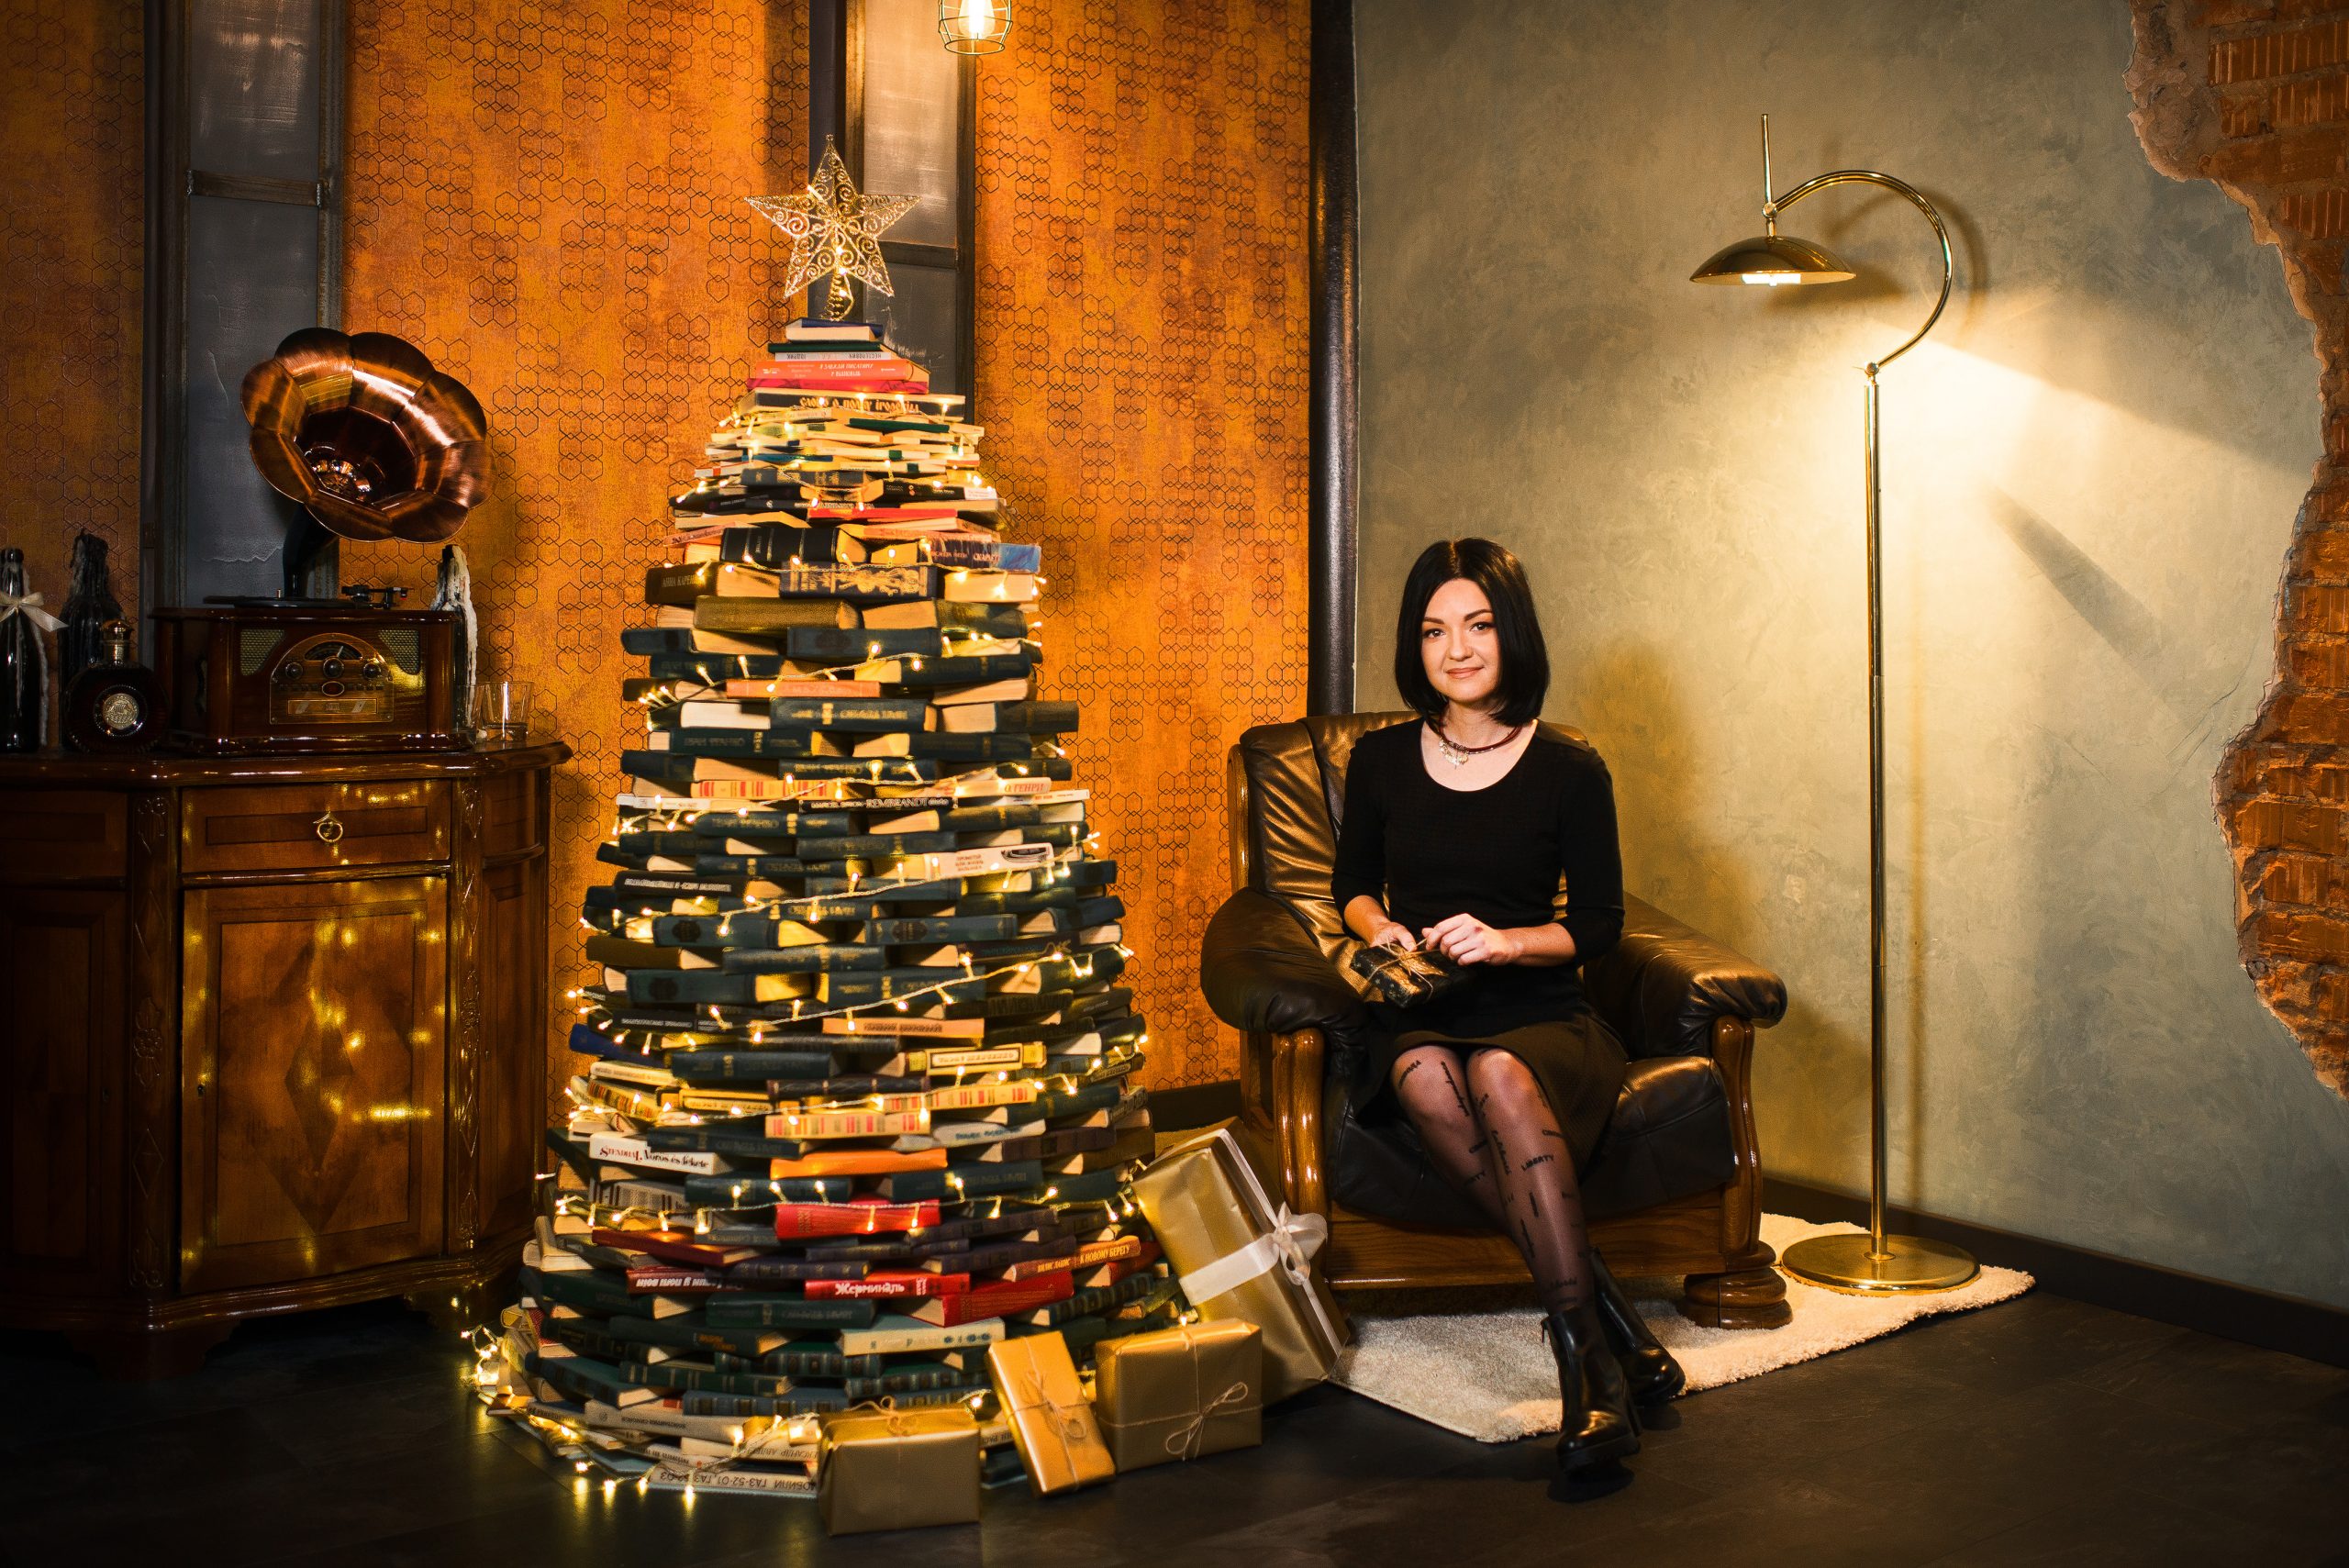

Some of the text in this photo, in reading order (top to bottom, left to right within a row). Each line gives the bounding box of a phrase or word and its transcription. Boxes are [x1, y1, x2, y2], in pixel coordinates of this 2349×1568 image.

[1013, 783, 1044, 793] ГЕНРИ
[865, 797, 928, 809] REMBRANDT
[1521, 1154, 1554, 1172] LIBERTY
[1085, 1249, 1108, 1262] НОВОМУ
[1109, 1244, 1130, 1257] БЕРЕГУ
[835, 1282, 905, 1298] Жерминаль
